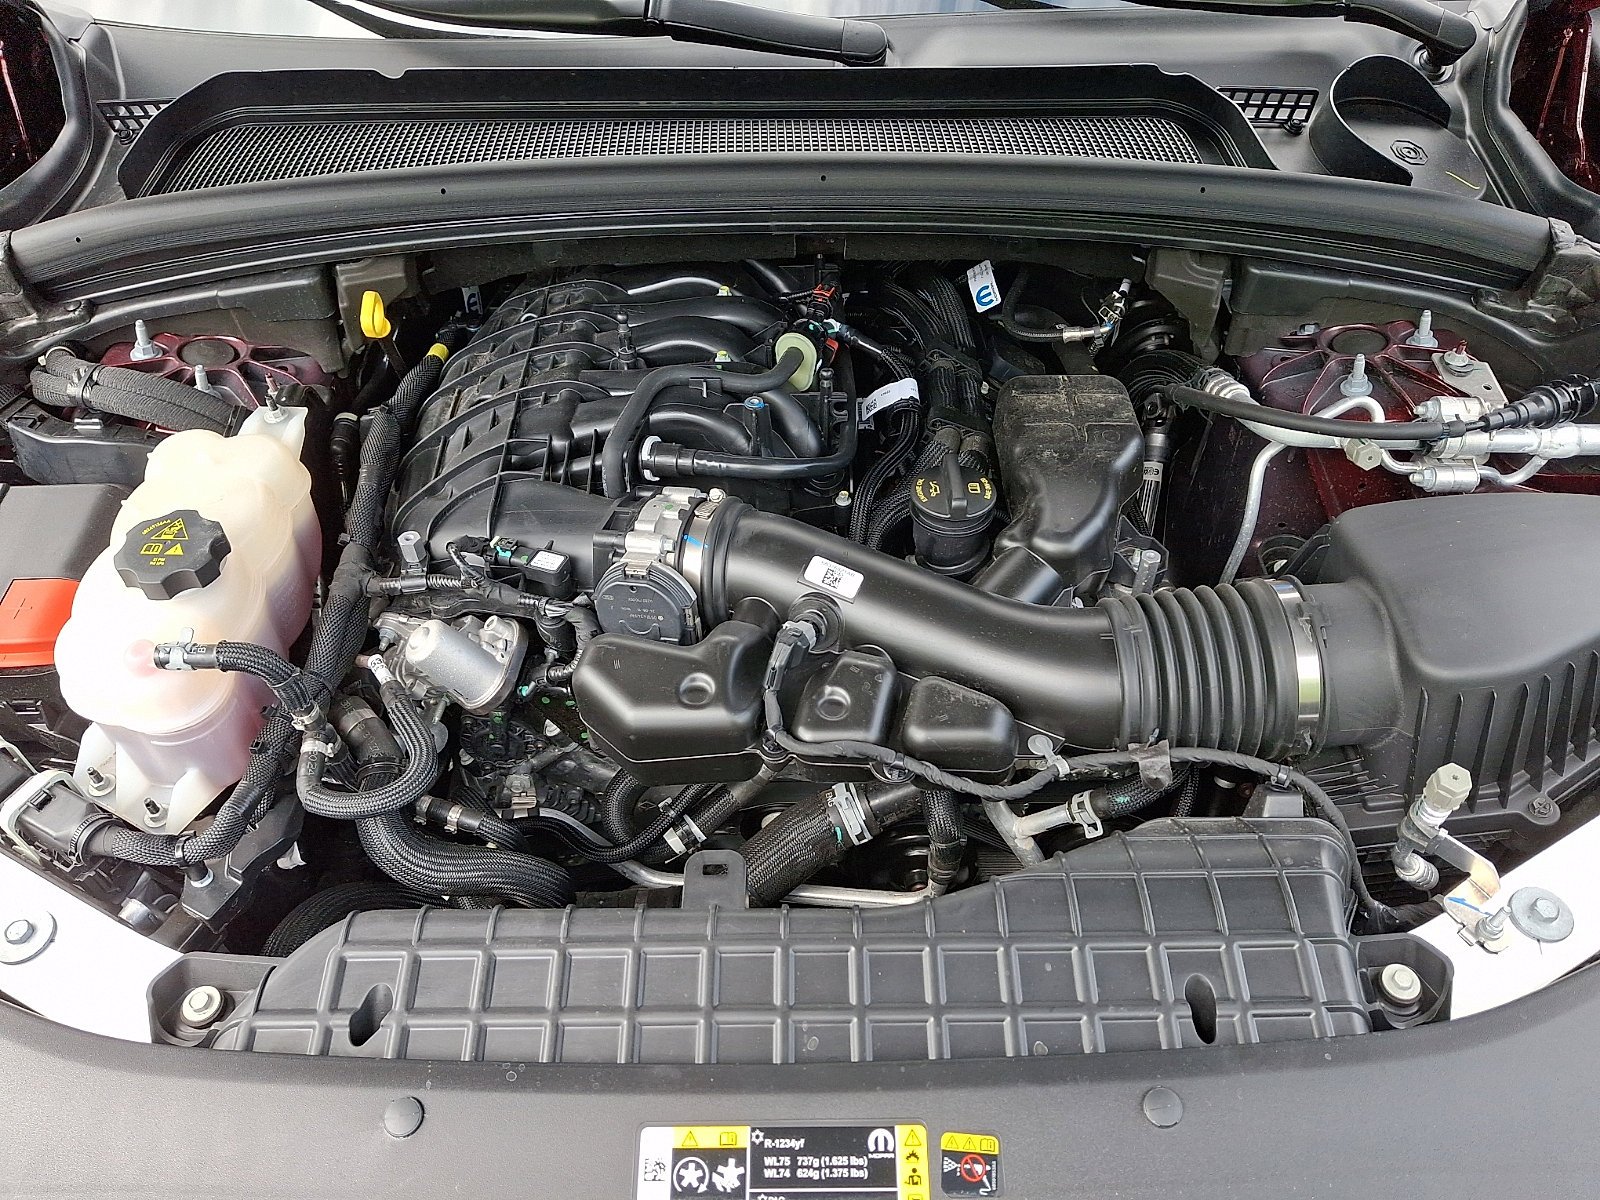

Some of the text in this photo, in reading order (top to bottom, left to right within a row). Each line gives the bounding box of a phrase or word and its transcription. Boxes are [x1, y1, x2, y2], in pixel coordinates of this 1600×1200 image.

[825, 792, 835, 808] ENG
[763, 1138, 806, 1150] R-1234yf
[763, 1156, 869, 1168] WL75 737g (1.625 lbs)
[763, 1168, 869, 1180] WL74 624g (1.375 lbs)
